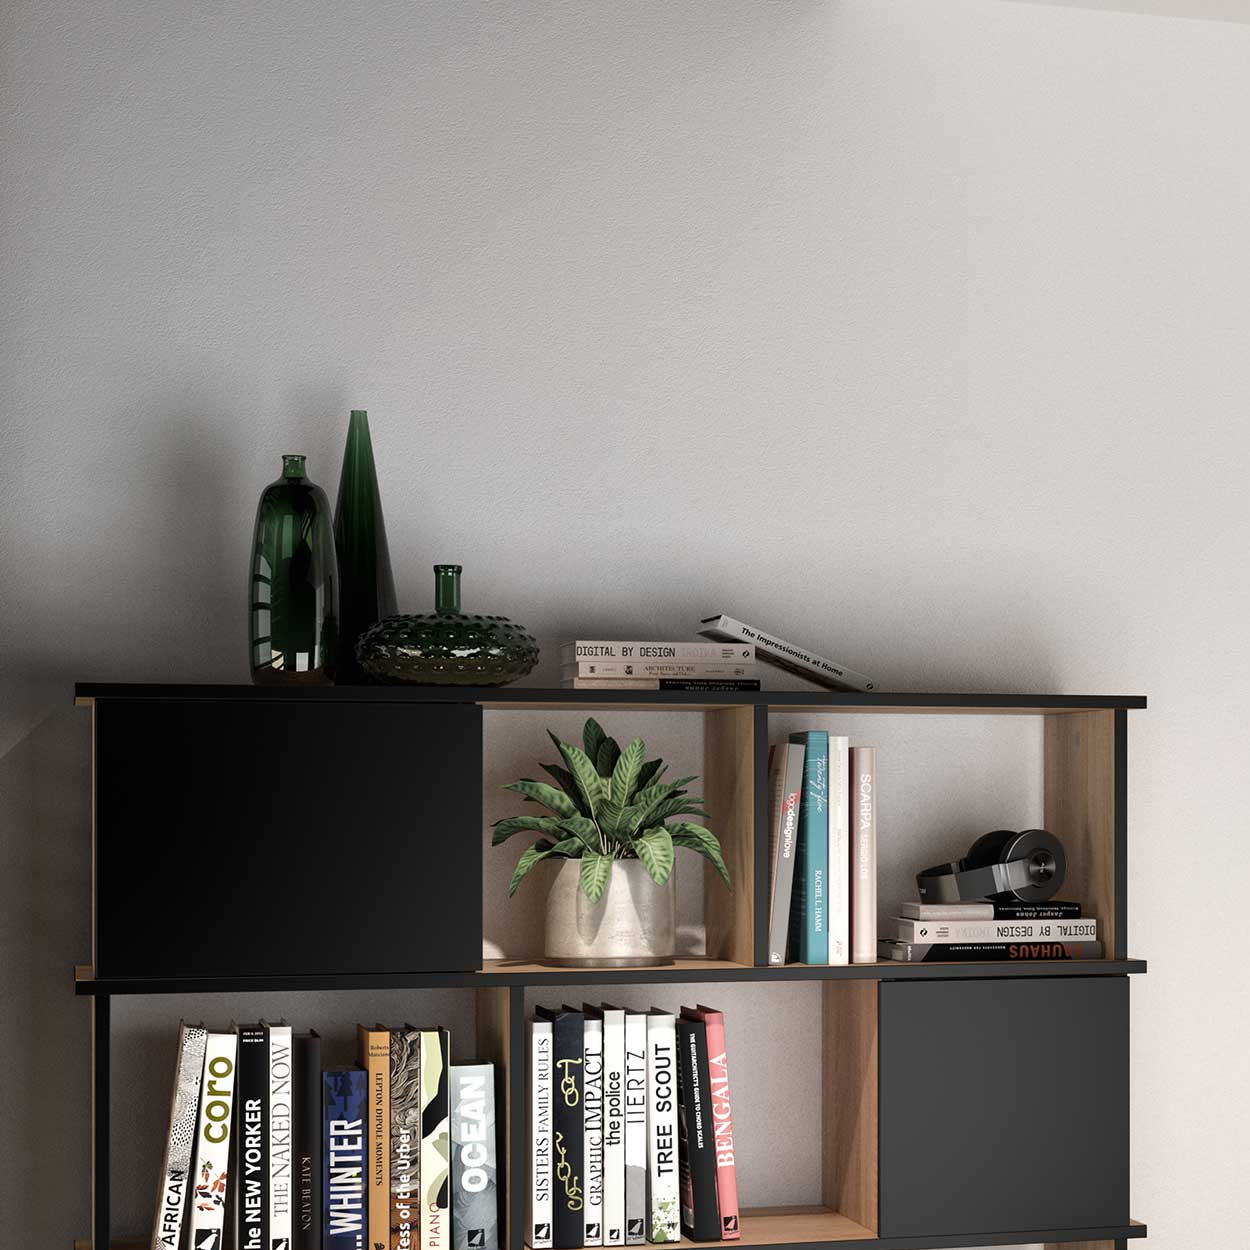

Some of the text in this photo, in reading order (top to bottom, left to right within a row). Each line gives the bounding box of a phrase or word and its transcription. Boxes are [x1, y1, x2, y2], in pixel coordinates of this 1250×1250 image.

[576, 647, 616, 657] DIGITAL
[622, 648, 635, 657] BY
[640, 648, 676, 658] DESIGN
[741, 627, 843, 677] The Impressionists at Home
[783, 793, 798, 858] logodesignlove
[860, 774, 871, 830] SCARPA
[815, 870, 823, 899] RACHEL
[815, 907, 823, 932] HAMM
[996, 926, 1032, 937] DESIGN
[1039, 925, 1051, 936] BY
[1056, 924, 1096, 936] DIGITAL
[245, 1099, 261, 1176] YORKER
[271, 1042, 290, 1217] THE NAKED NOW
[376, 1072, 384, 1186] LEPTON DIPOLE MOMENTS
[459, 1076, 488, 1192] OCEAN
[536, 1038, 550, 1201] SISTERS FAMILY RULES
[585, 1048, 602, 1206] GRAPHIC IMPACT
[605, 1071, 624, 1146] the police
[654, 1044, 673, 1177] TREE SCOUT
[710, 1052, 735, 1168] BENGALA
[162, 1169, 185, 1246] AFRICAN
[245, 1180, 261, 1223] NEW
[302, 1157, 312, 1231] KATE BEATON
[396, 1174, 410, 1200] the
[396, 1202, 410, 1219] of
[429, 1202, 440, 1247] PIANO
